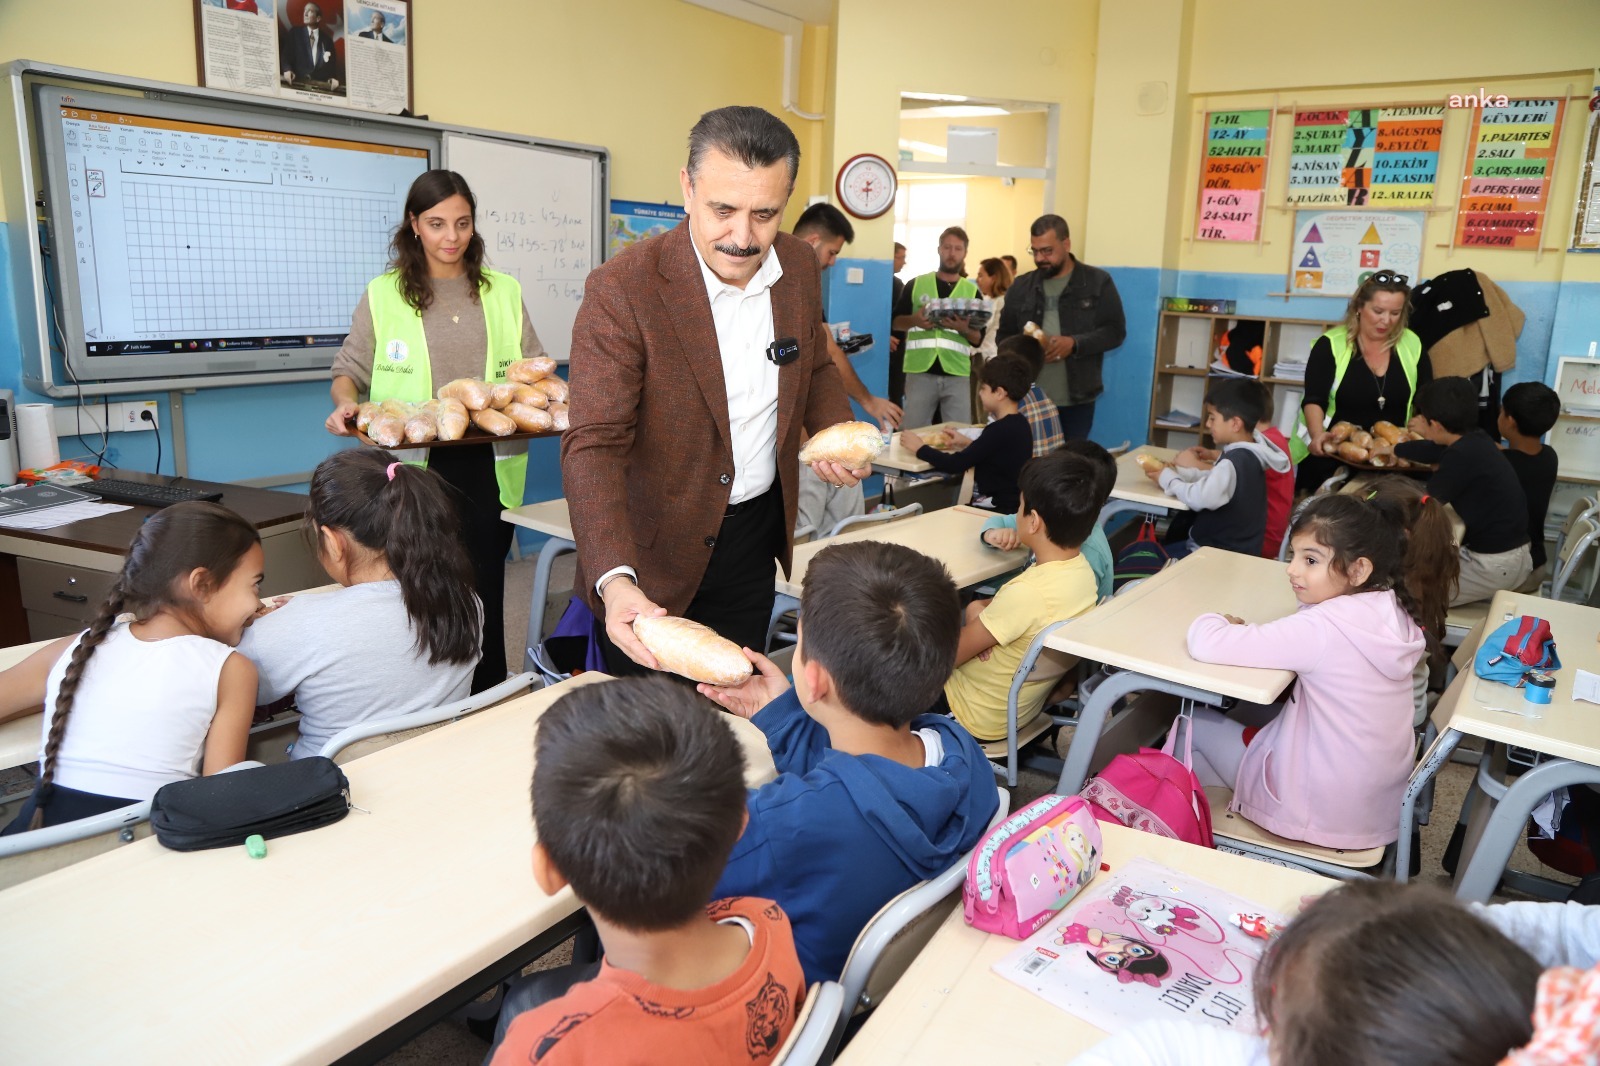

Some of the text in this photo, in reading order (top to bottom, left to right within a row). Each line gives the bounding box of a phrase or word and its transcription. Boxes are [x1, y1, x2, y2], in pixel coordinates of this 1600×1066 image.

[1381, 106, 1445, 116] 7.TEMMUZ
[1214, 115, 1240, 125] 1-YIL
[1296, 112, 1340, 121] 1.OCAK
[1482, 112, 1548, 123] GÜNLERİ
[1294, 130, 1347, 141] 2.ŞUBAT
[1378, 126, 1442, 136] 8.AĞUSTOS
[1481, 130, 1551, 142] 1.PAZARTESİ
[1293, 145, 1341, 153] 3.MART
[1377, 139, 1429, 150] 9.EYLÜL
[1208, 147, 1261, 156] 52-HAFTA
[1477, 149, 1515, 159] 2.SALI
[1292, 160, 1340, 171] 4.NİSAN
[1375, 157, 1428, 169] 10.EKİM
[1290, 176, 1339, 185] 5.MAYIS
[1373, 174, 1435, 184] 11.KASIM
[1371, 191, 1434, 200] 12.ARALIK
[1468, 203, 1512, 211] 5.CUMA
[1467, 218, 1535, 228] 6.CUMARTESİ
[1465, 235, 1513, 245] 7.PAZAR
[1158, 972, 1212, 1012] DANCE!
